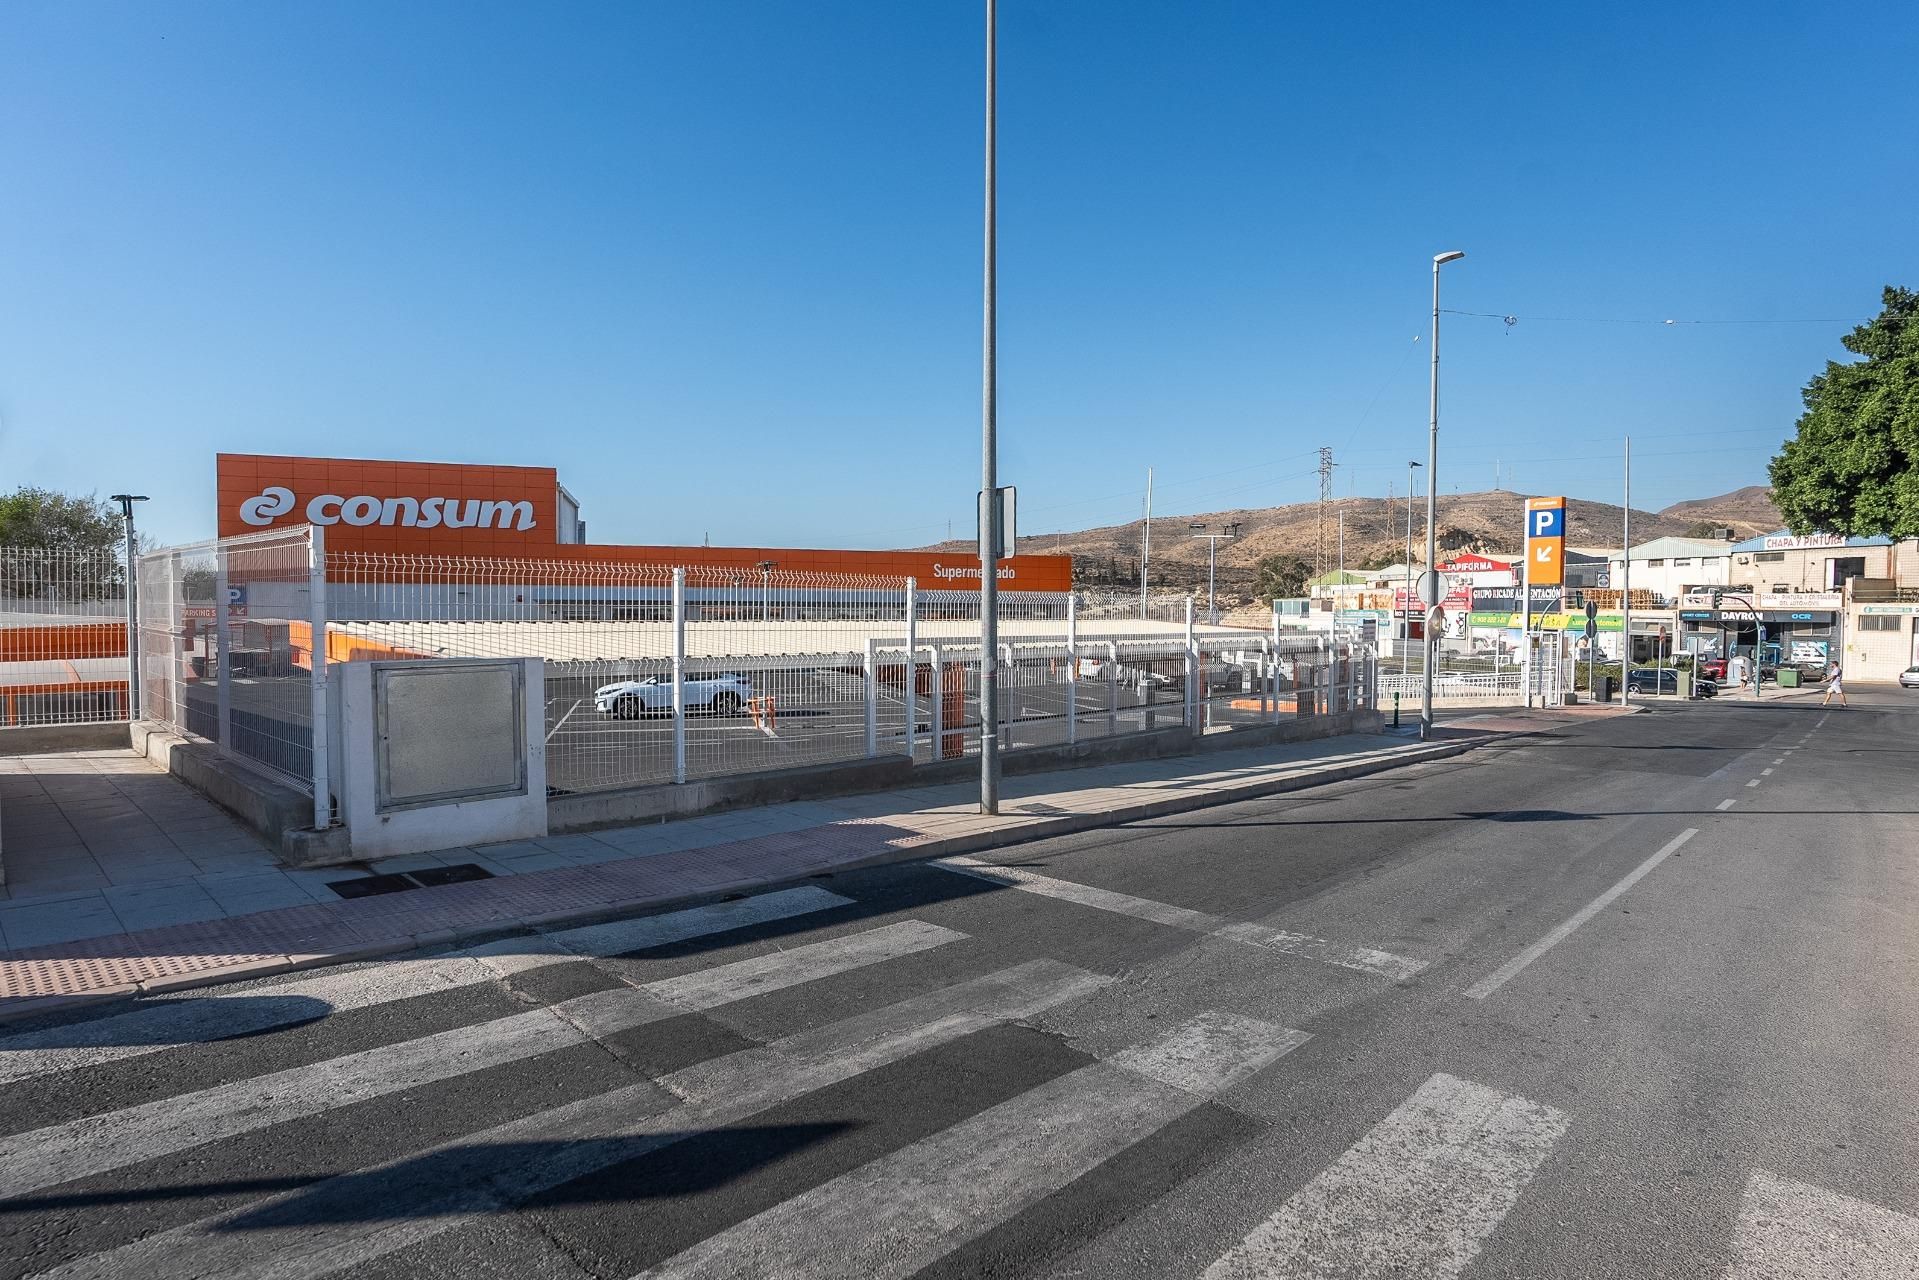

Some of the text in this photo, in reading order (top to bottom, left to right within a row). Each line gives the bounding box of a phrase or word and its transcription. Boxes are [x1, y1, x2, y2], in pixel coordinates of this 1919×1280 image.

[305, 493, 537, 532] consum
[1536, 511, 1554, 536] P
[1766, 537, 1794, 549] CHAPA
[1796, 536, 1802, 547] Y
[1446, 561, 1493, 571] TAPIFORMA
[933, 563, 1016, 582] Supermeado
[1473, 588, 1492, 599] GRUPO
[181, 609, 210, 617] PARKING
[1721, 611, 1763, 621] DAYRON
